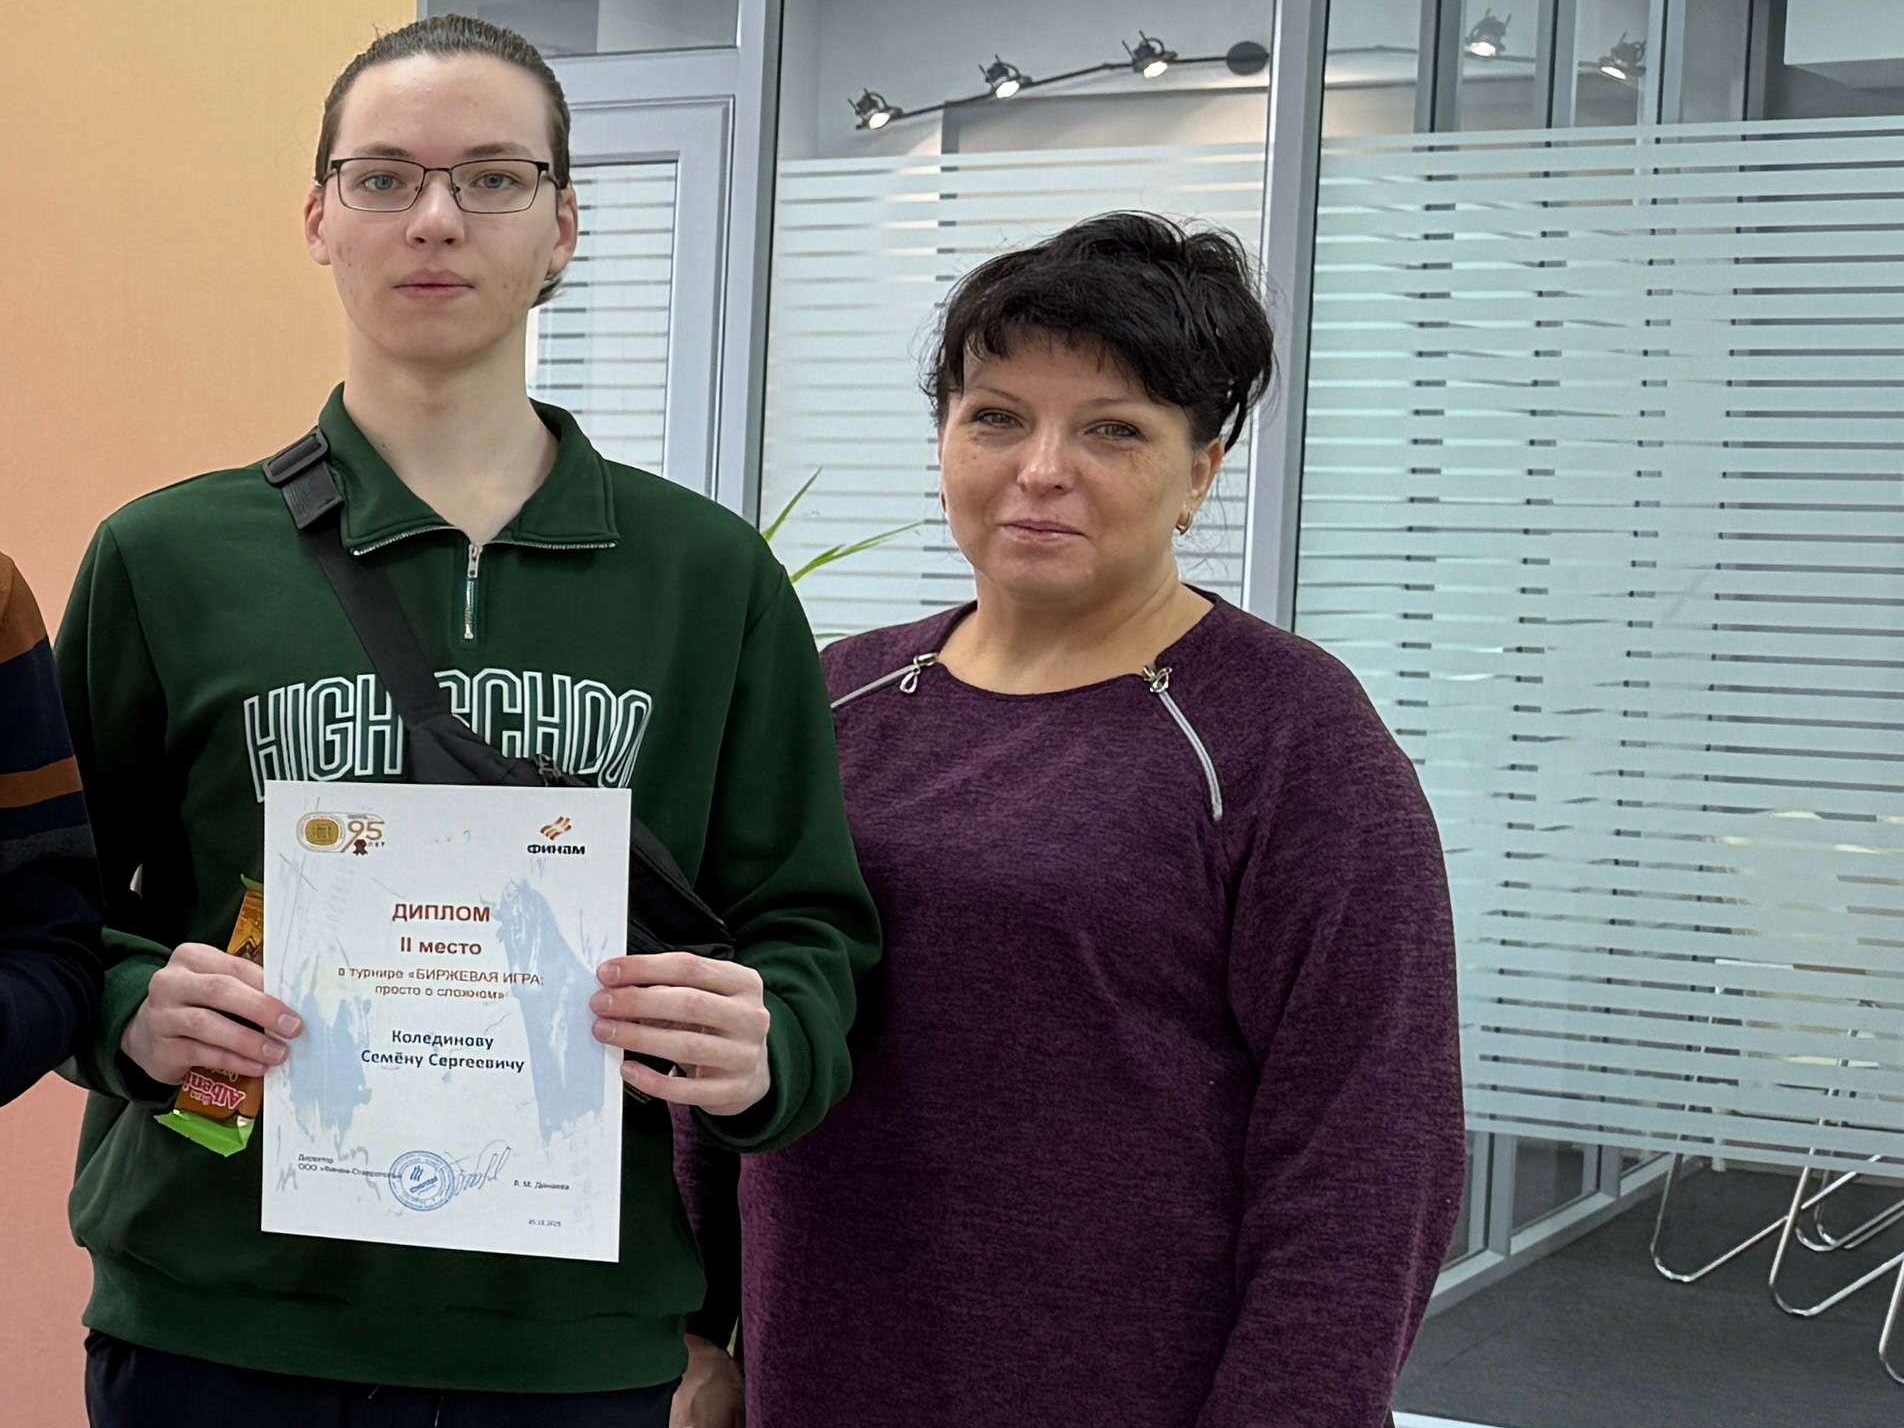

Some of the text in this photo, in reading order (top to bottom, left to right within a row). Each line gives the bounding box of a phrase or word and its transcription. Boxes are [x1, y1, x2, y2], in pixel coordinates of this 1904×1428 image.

[244, 673, 404, 803] HIGH
[392, 903, 490, 922] ДИПЛОМ
[400, 936, 482, 955] II место
[350, 968, 404, 980] турнире
[408, 968, 499, 983] «БИРЖЕВАЯ
[375, 985, 421, 996] просто
[425, 988, 433, 996] о
[392, 1030, 494, 1050] Колединову
[361, 1050, 525, 1073] Семёну Сергеевичу
